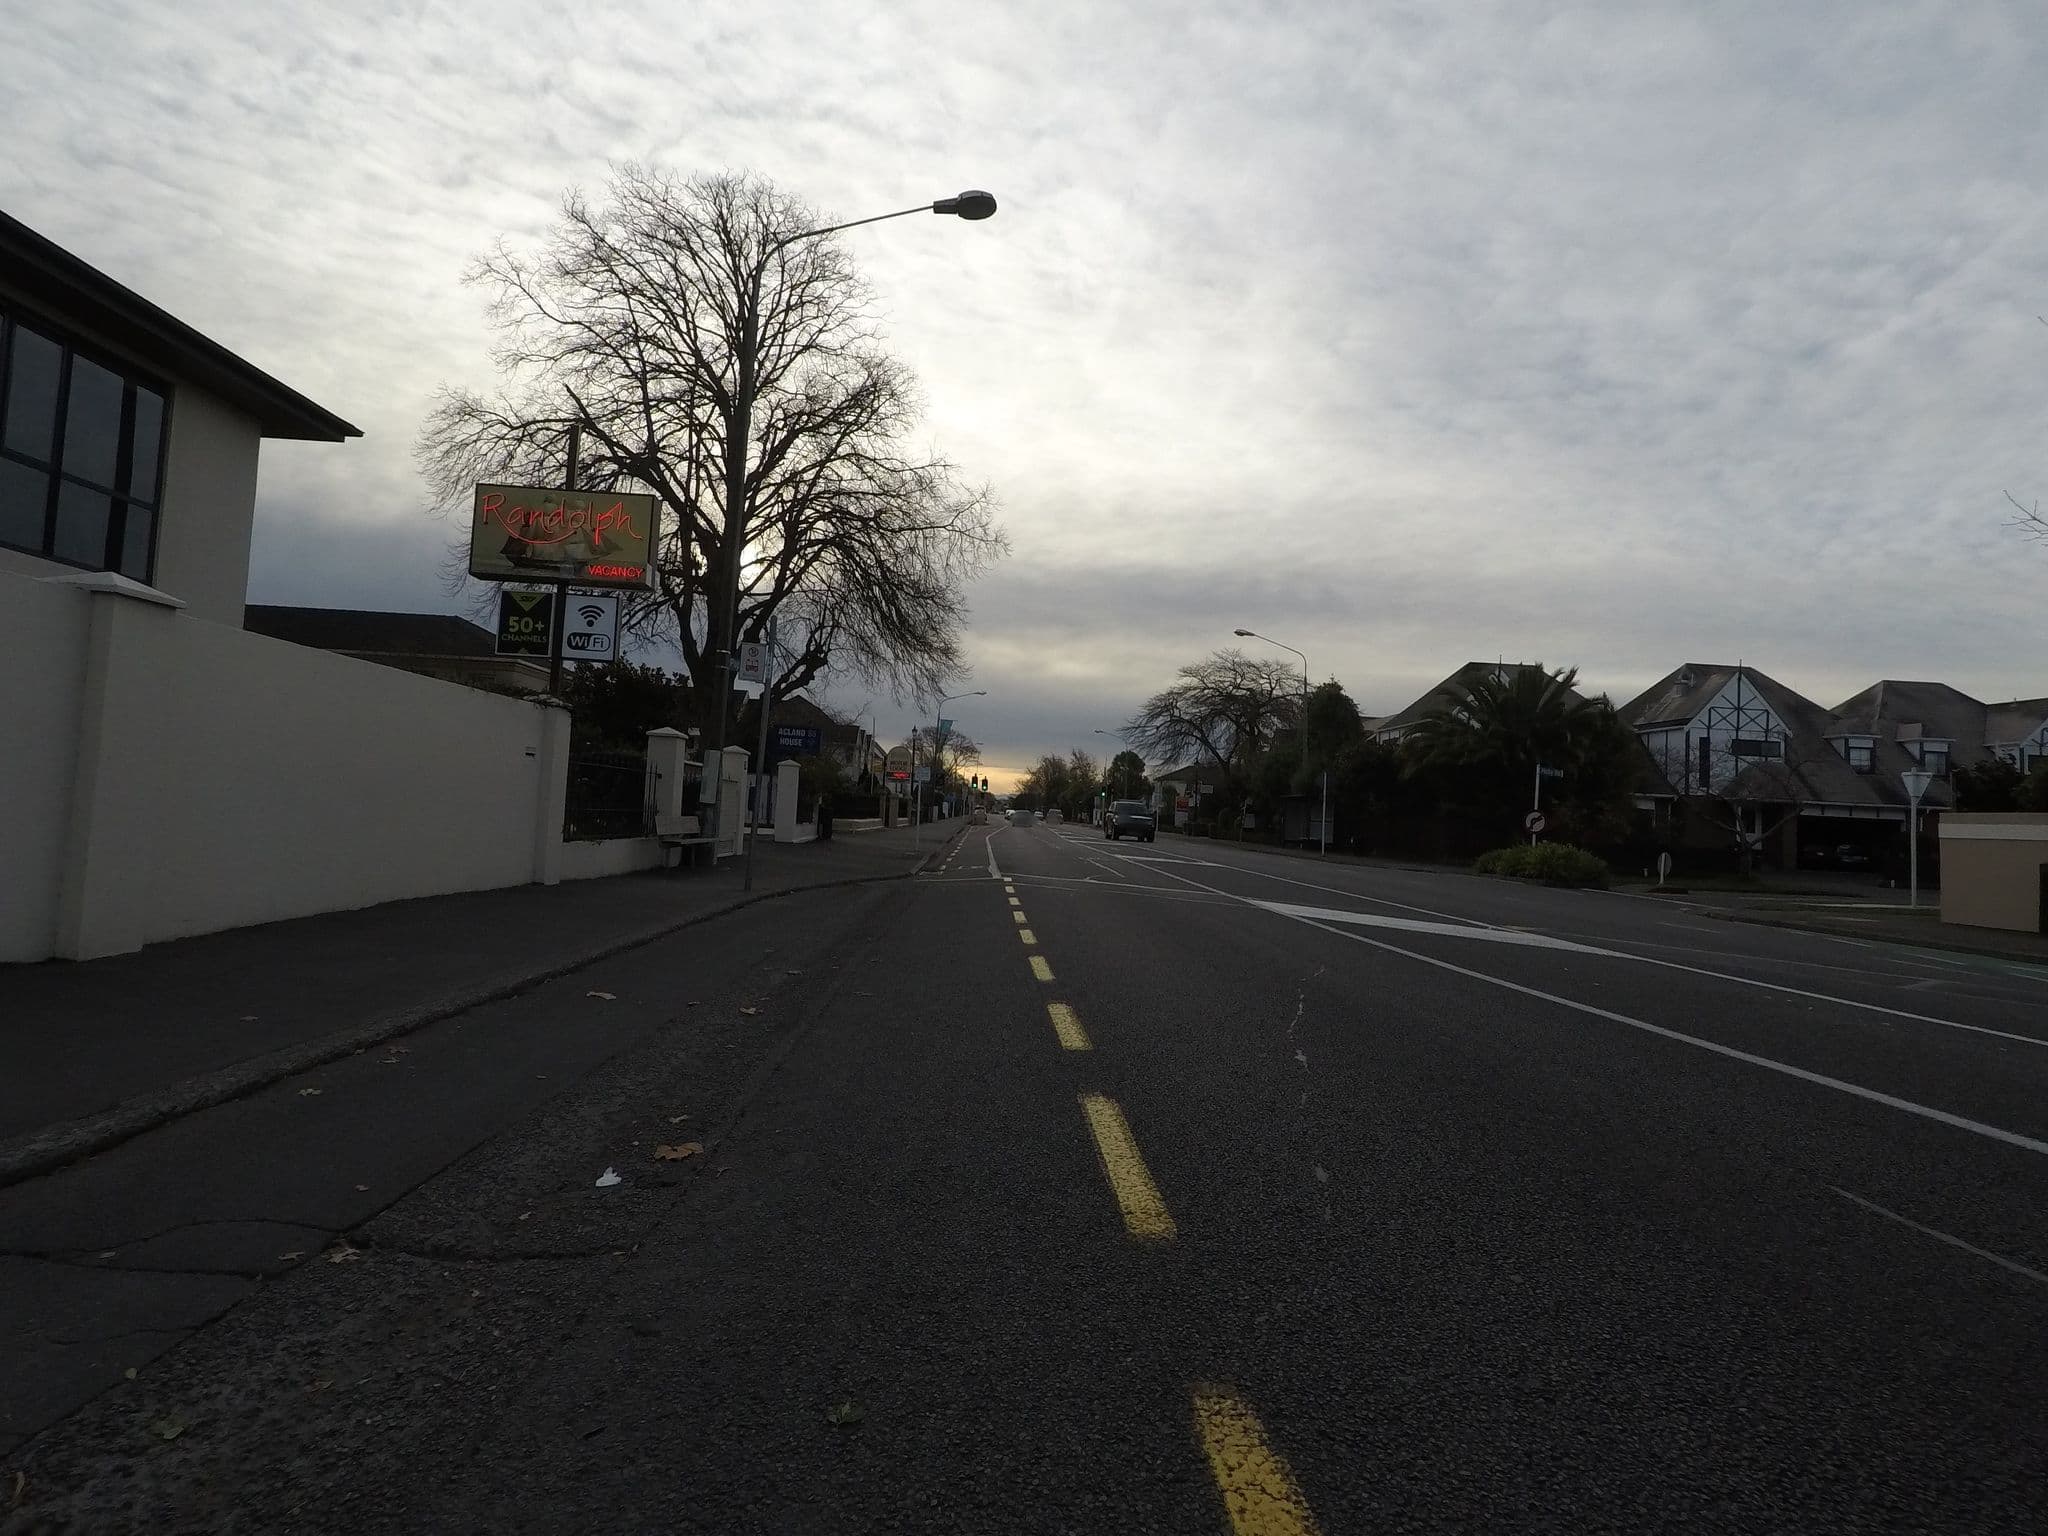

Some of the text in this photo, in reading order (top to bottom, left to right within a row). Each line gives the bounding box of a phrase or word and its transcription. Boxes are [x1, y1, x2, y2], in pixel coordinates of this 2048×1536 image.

[482, 492, 644, 545] Randolph
[587, 565, 644, 578] VACANCY
[508, 616, 545, 633] 50+
[501, 633, 548, 643] CHANNELS
[779, 737, 803, 746] HOUSE
